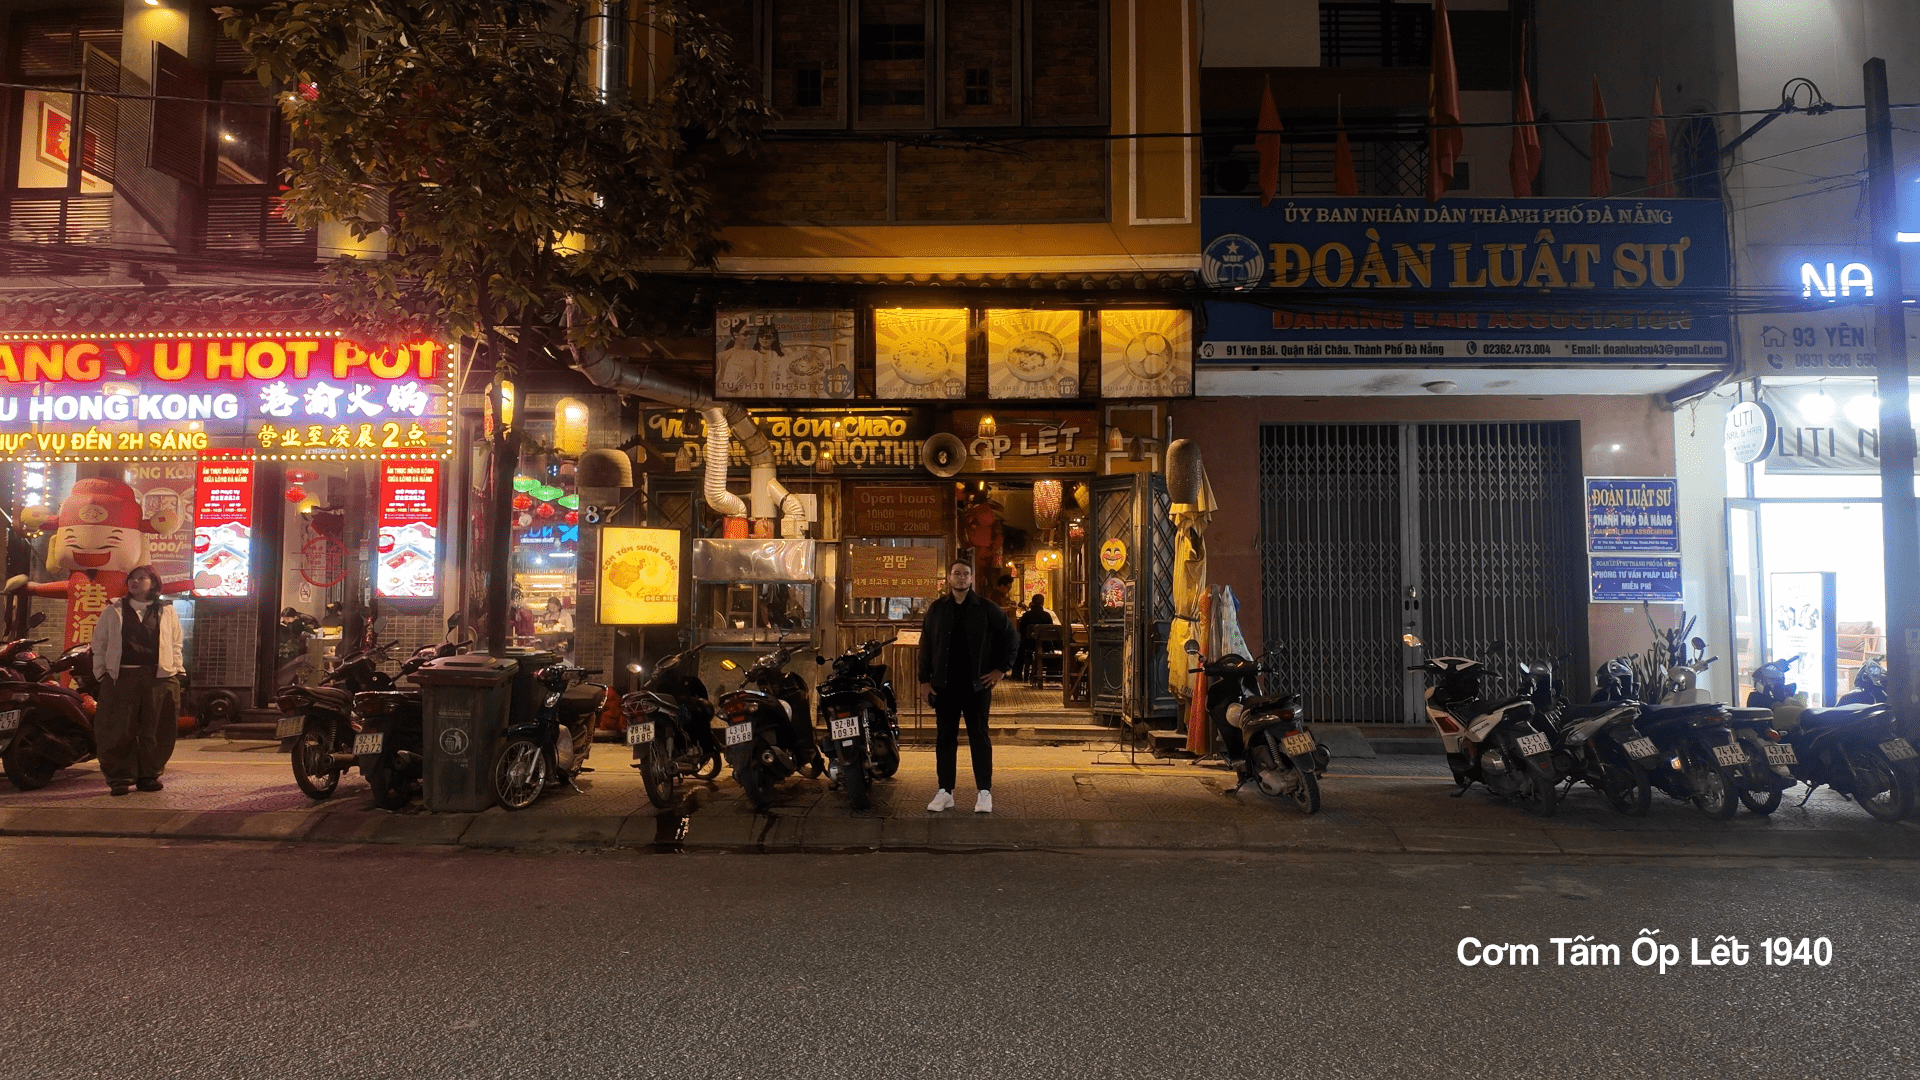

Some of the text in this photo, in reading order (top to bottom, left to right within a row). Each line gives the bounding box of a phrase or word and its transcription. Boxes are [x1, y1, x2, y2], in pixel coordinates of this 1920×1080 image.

[1284, 201, 1673, 224] ỦY BAN NHÂN DÂN THÀNH PHỐ ĐÀ NẴNG
[1268, 227, 1691, 293] ĐOÀN LUẬT SƯ
[1793, 322, 1865, 347] 93 YÊN
[1226, 345, 1237, 355] 91
[1240, 344, 1257, 355] Yên
[1281, 345, 1304, 358] Quận
[1307, 344, 1322, 355] Hải
[1354, 344, 1381, 355] Thành
[1384, 342, 1403, 355] Phố
[1405, 344, 1418, 355] Đà
[1420, 341, 1444, 355] Nẵng
[1483, 343, 1723, 356] 02362.473.004 Email: doanluatsu43@gmail.com
[206, 340, 319, 380] HOT
[333, 340, 445, 380] POT
[827, 381, 851, 394] 10%
[29, 396, 130, 421] HONG
[138, 393, 239, 420] KONG
[259, 380, 428, 419] 港渝火锅
[1733, 410, 1753, 427] LITI
[37, 433, 67, 454] VỤ
[71, 426, 113, 450] ĐẾN
[118, 433, 145, 450] 2H
[149, 429, 208, 450] SÁNG
[257, 422, 427, 449] 营业至凌晨2点
[1778, 426, 1836, 457] LITI
[1048, 455, 1088, 467] 1940
[860, 493, 936, 506] Open hours
[1592, 484, 1672, 511] ĐOÀN LUẬT SƯ
[867, 509, 932, 519] 10h00 14h00
[870, 522, 929, 531] 16h30 22h00
[1619, 570, 1627, 578] TƯ
[833, 727, 857, 738] 109.31
